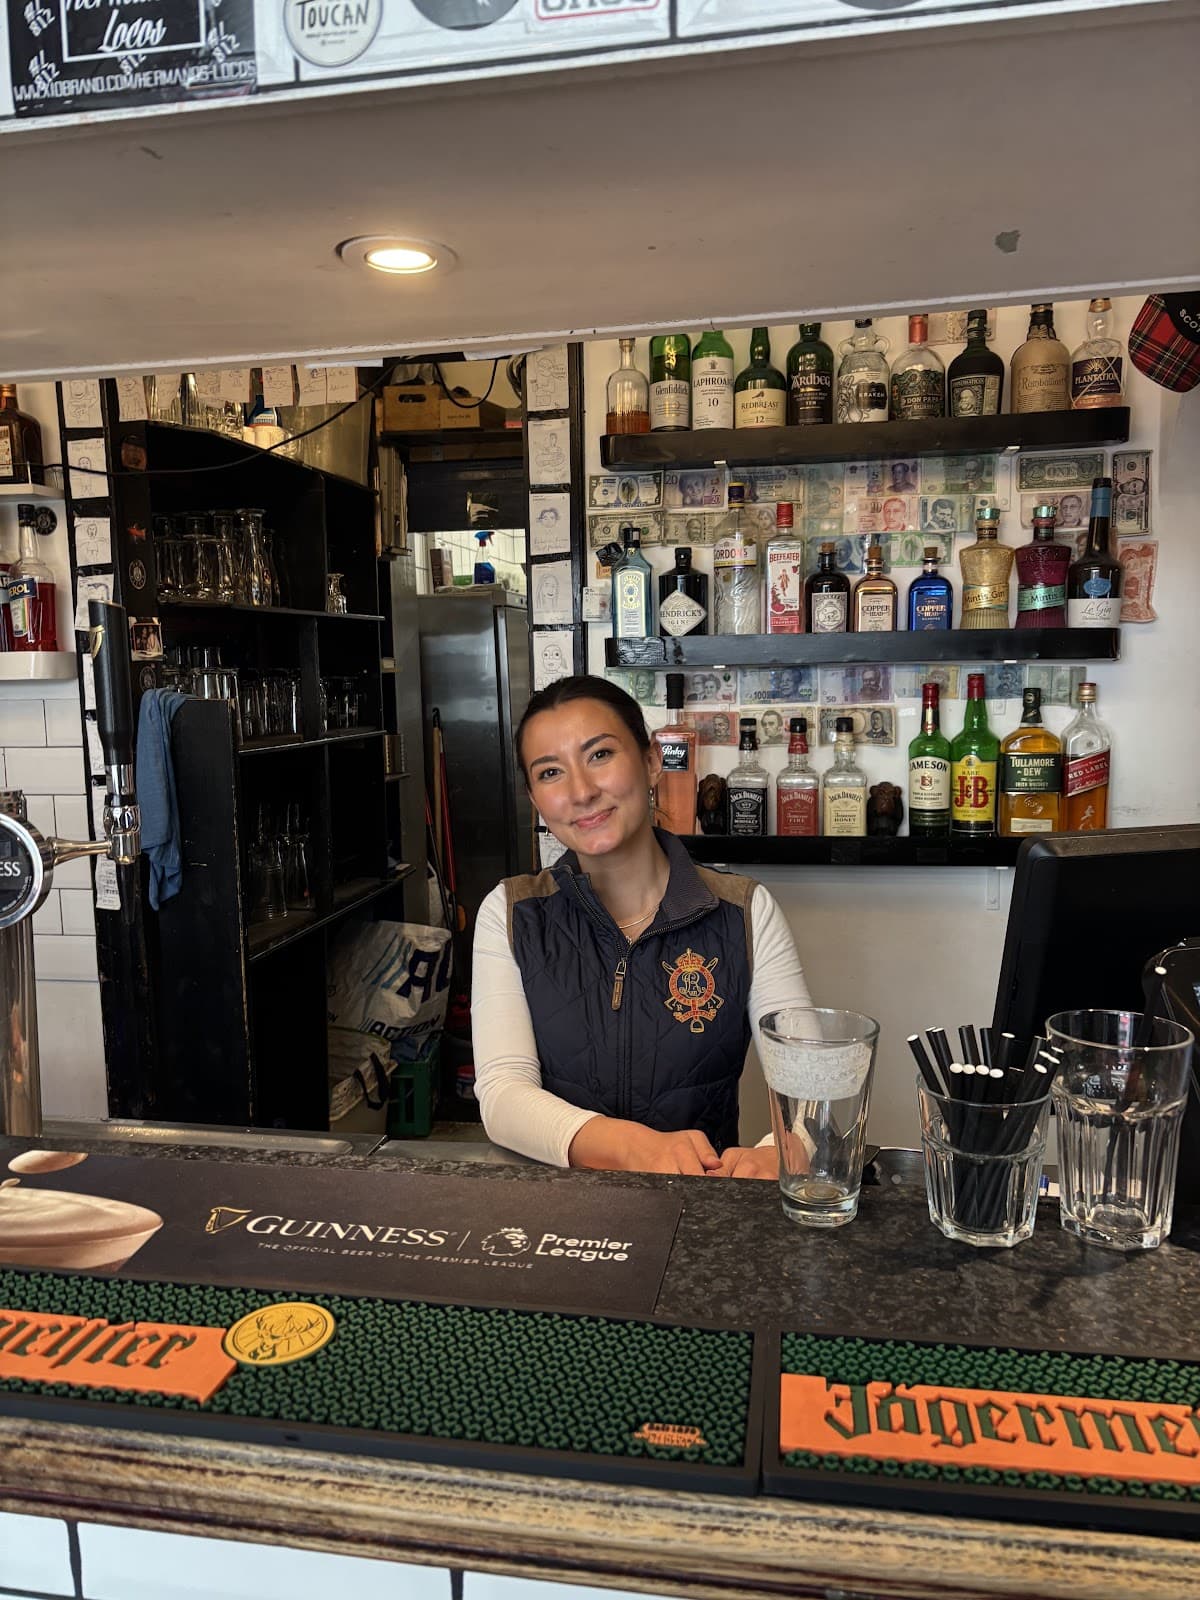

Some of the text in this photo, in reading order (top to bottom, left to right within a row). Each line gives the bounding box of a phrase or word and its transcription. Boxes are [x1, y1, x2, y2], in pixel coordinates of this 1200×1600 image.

[296, 0, 369, 30] TOUCAN
[97, 9, 168, 52] Locos
[707, 397, 719, 407] 10
[741, 400, 779, 411] REDBREAST
[755, 416, 766, 424] 12
[769, 552, 800, 563] BEEFEATER
[7, 583, 30, 597] EROL
[662, 745, 686, 758] Pinky
[910, 760, 948, 772] JAMESON
[1010, 756, 1055, 767] TULLAMORE
[1023, 768, 1042, 776] DEW
[1068, 763, 1109, 779] RED LABEL
[246, 1215, 449, 1247] GUINNESS
[542, 1233, 633, 1250] Premier
[258, 1242, 278, 1250] THE
[284, 1244, 336, 1254] OFFICIAL
[341, 1249, 372, 1257] BEER
[398, 1253, 421, 1261] THE
[424, 1255, 480, 1265] PREMIER
[484, 1260, 534, 1269] LEAGUE
[535, 1247, 629, 1262] League
